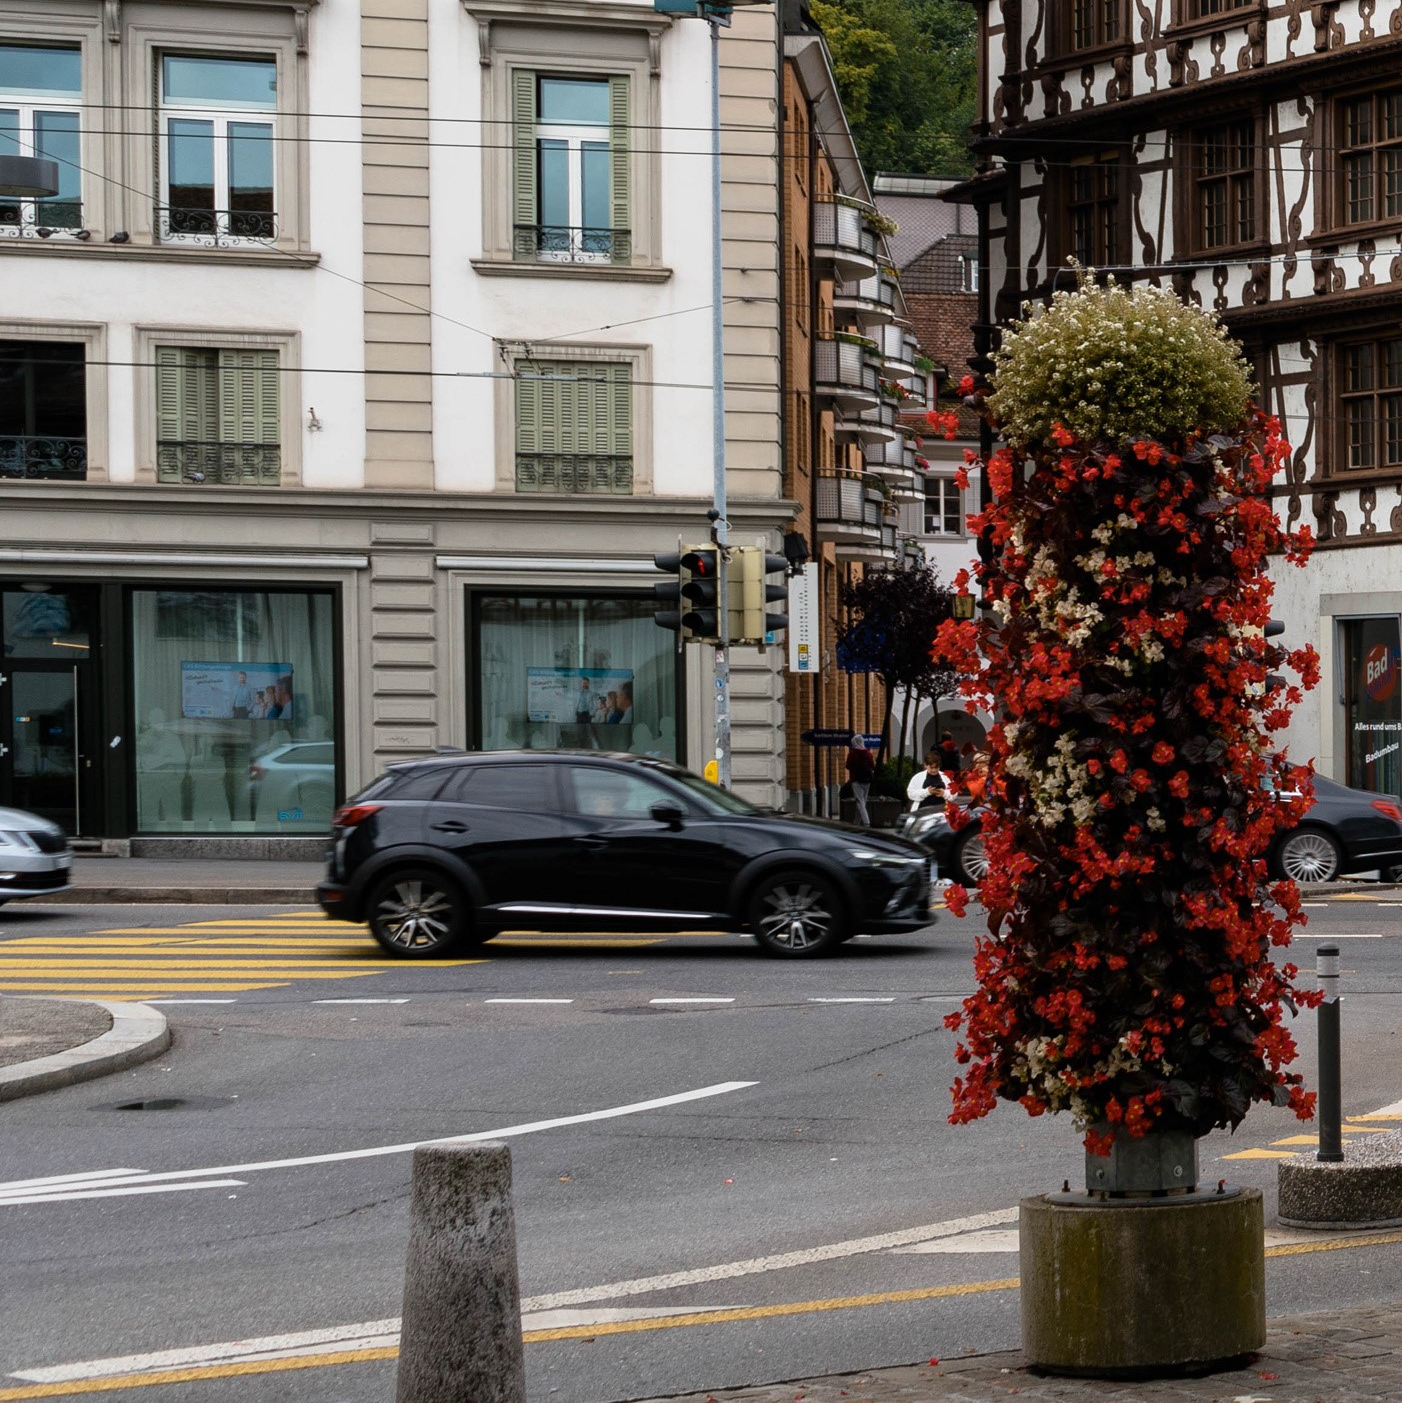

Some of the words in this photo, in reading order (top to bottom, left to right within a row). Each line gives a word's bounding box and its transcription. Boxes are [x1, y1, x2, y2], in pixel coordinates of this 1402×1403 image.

[1367, 647, 1388, 685] Bad
[1354, 722, 1369, 730] Alles
[1370, 722, 1384, 730] rund
[1366, 742, 1399, 764] Badumbau
